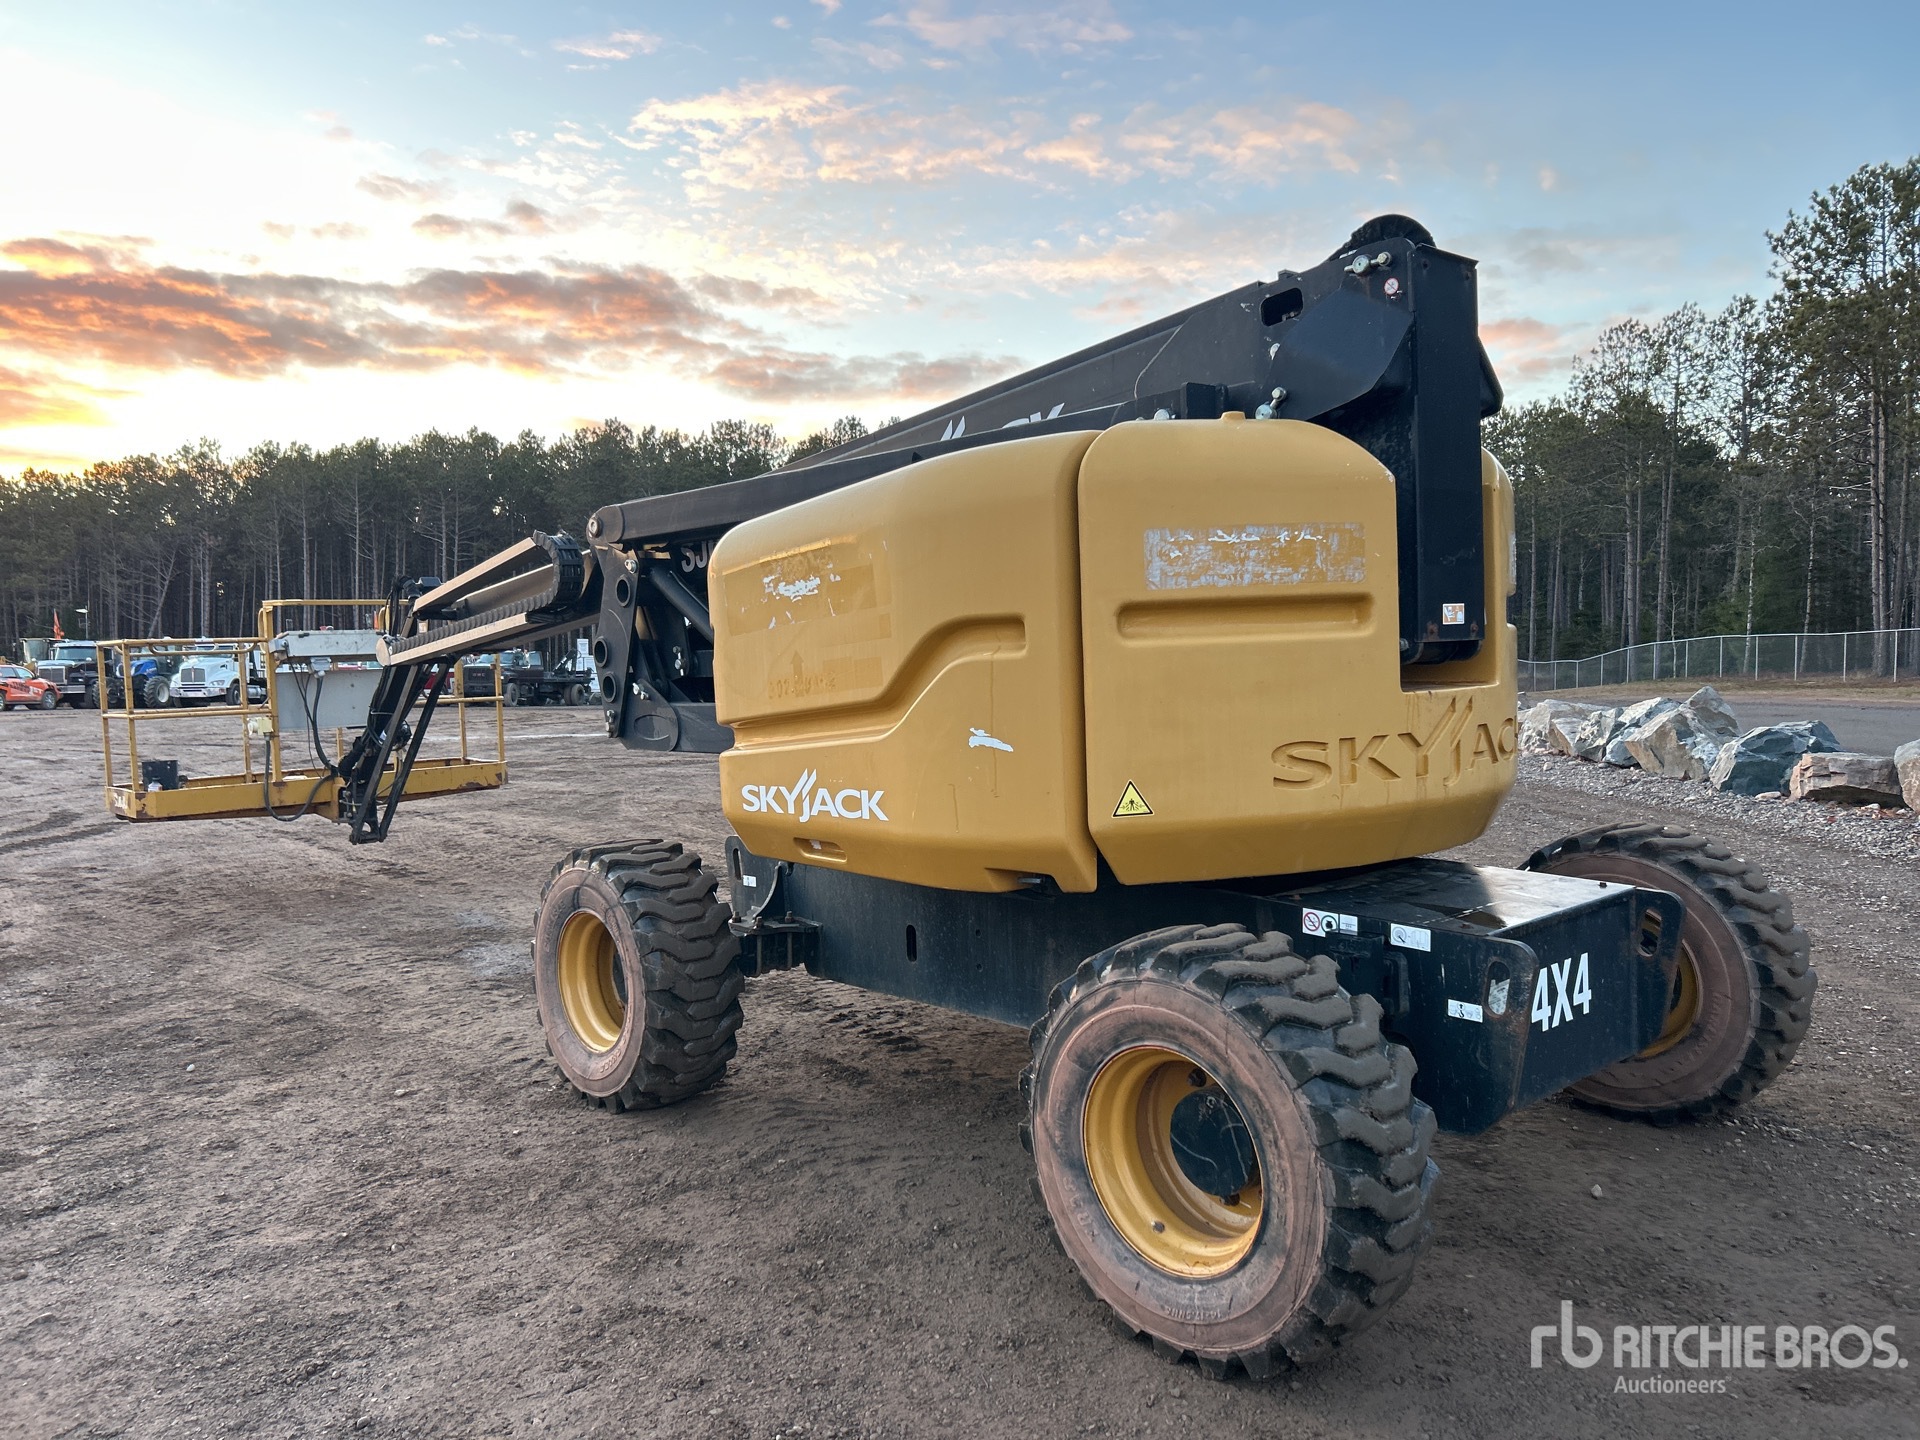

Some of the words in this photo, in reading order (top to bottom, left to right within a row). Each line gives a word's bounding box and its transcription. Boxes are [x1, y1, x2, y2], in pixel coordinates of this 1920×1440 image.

[1271, 695, 1518, 790] SKYJAC
[741, 768, 889, 822] SKYJACK
[1531, 952, 1592, 1032] 4X4
